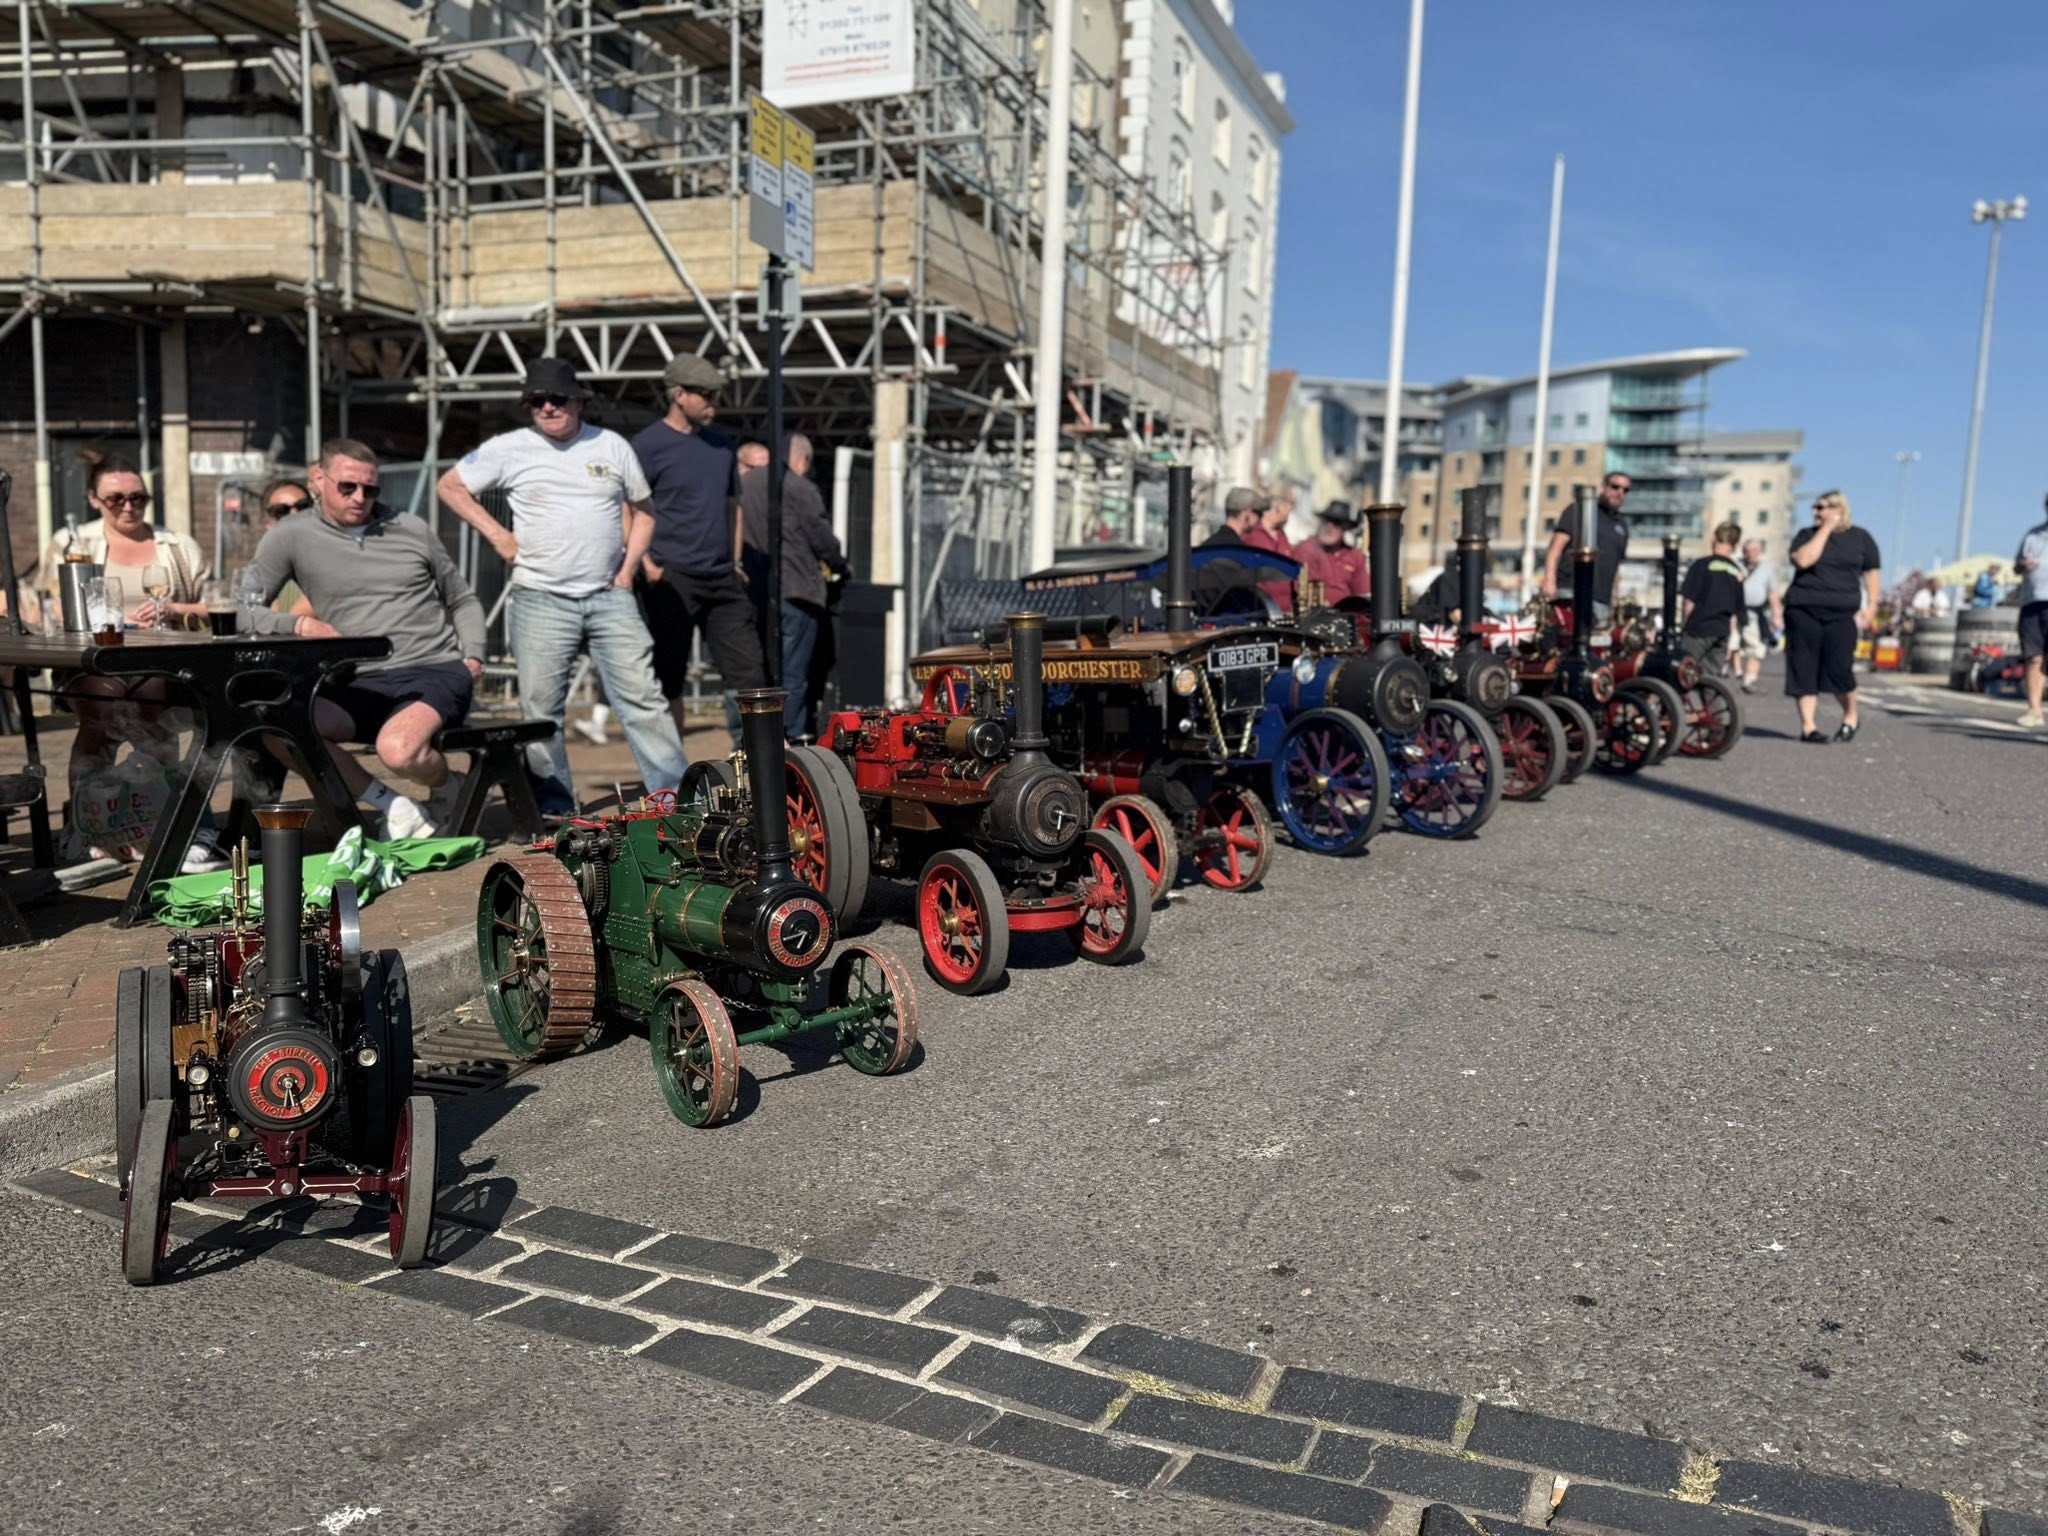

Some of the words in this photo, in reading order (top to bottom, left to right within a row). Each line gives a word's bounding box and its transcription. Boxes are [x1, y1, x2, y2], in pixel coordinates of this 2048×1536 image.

[1246, 647, 1268, 663] GPR
[255, 1054, 273, 1071] THE
[248, 1086, 286, 1117] TRACTION
[290, 1091, 322, 1116] ENGINE
